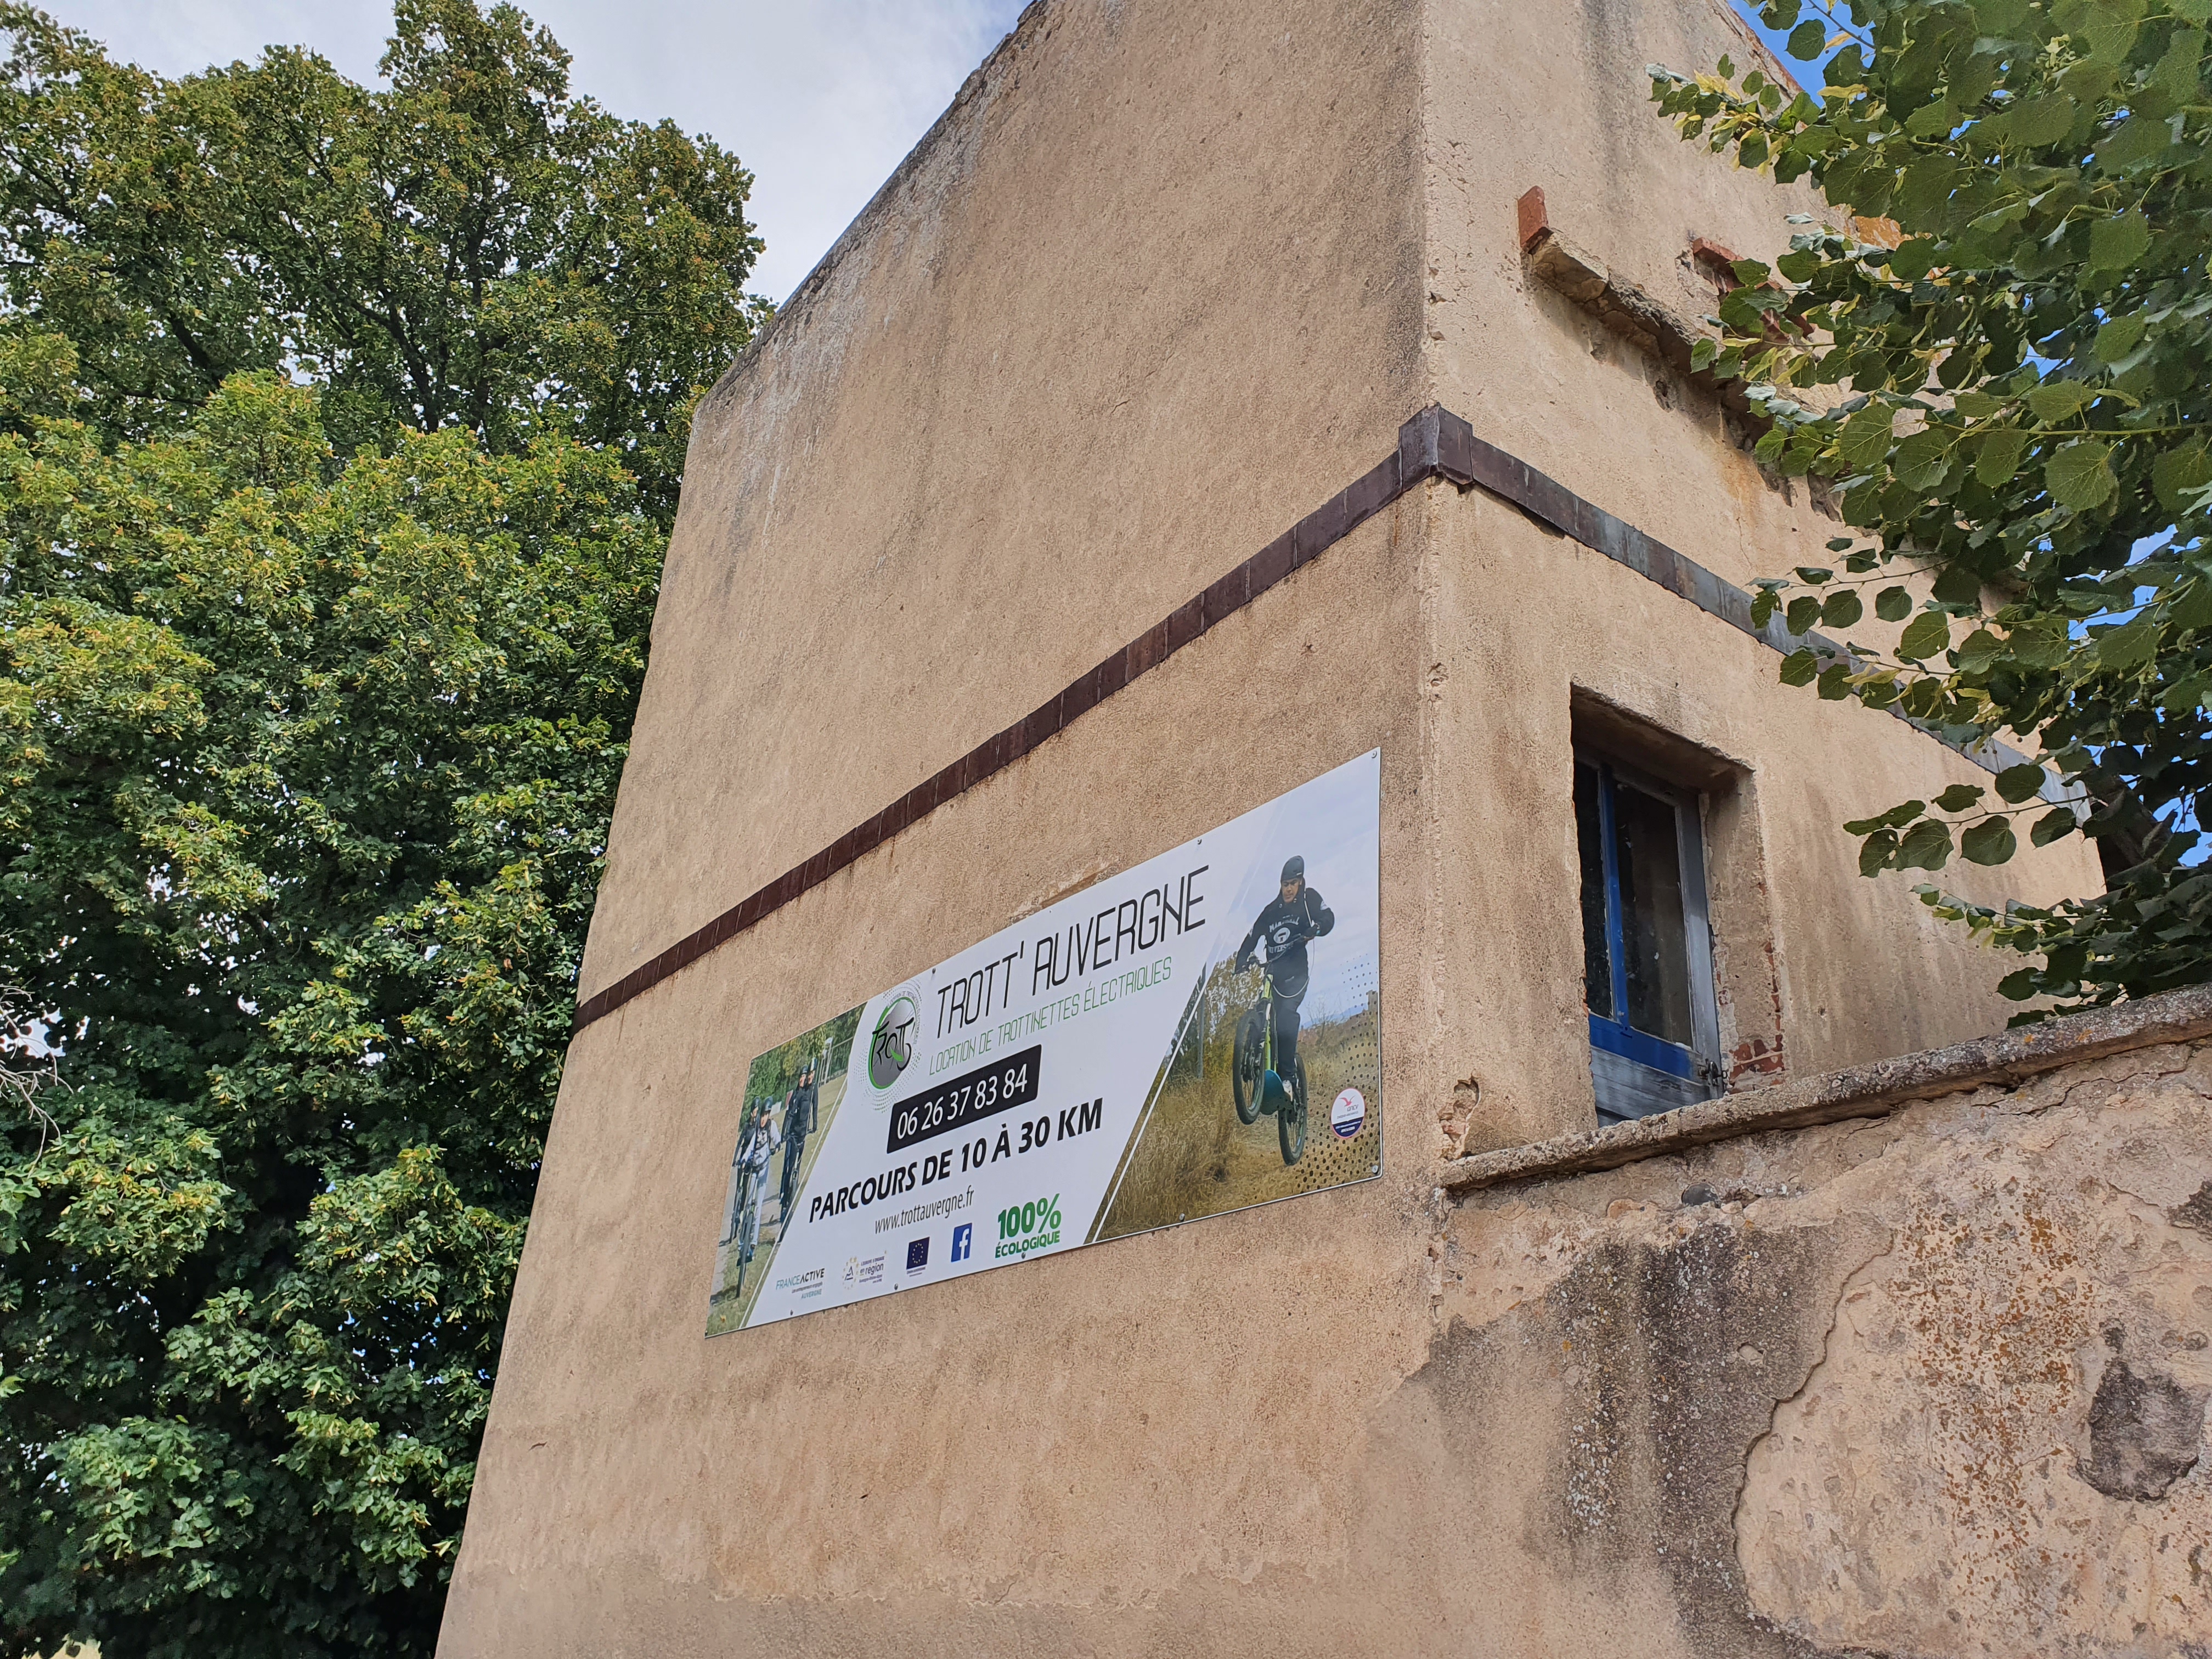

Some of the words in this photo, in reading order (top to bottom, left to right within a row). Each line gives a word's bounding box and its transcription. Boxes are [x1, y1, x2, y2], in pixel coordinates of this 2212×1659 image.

[937, 940, 1024, 1039] TROTT'
[1032, 865, 1209, 996] AUVERGNE
[929, 1036, 976, 1076] LOCATION
[979, 1029, 994, 1055] DE
[998, 994, 1079, 1046] TROTTINETTES
[1084, 956, 1172, 1012] ÉLECTRIQUES
[897, 1108, 918, 1139] 06
[921, 1096, 944, 1131] 26
[947, 1085, 971, 1120] 37
[974, 1075, 998, 1109] 83
[1002, 1063, 1027, 1099] 84
[809, 1161, 917, 1223] PARCOURS
[922, 1148, 953, 1186] DE
[961, 1137, 986, 1173] 10
[991, 1123, 1011, 1163] À
[1018, 1115, 1050, 1153] 30
[1057, 1097, 1103, 1141] KM
[874, 1184, 974, 1234] www.trottauvergne.fr
[997, 1192, 1061, 1240] 100%
[865, 1263, 884, 1276] région
[995, 1230, 1060, 1258] ÉCOLOGIQUE
